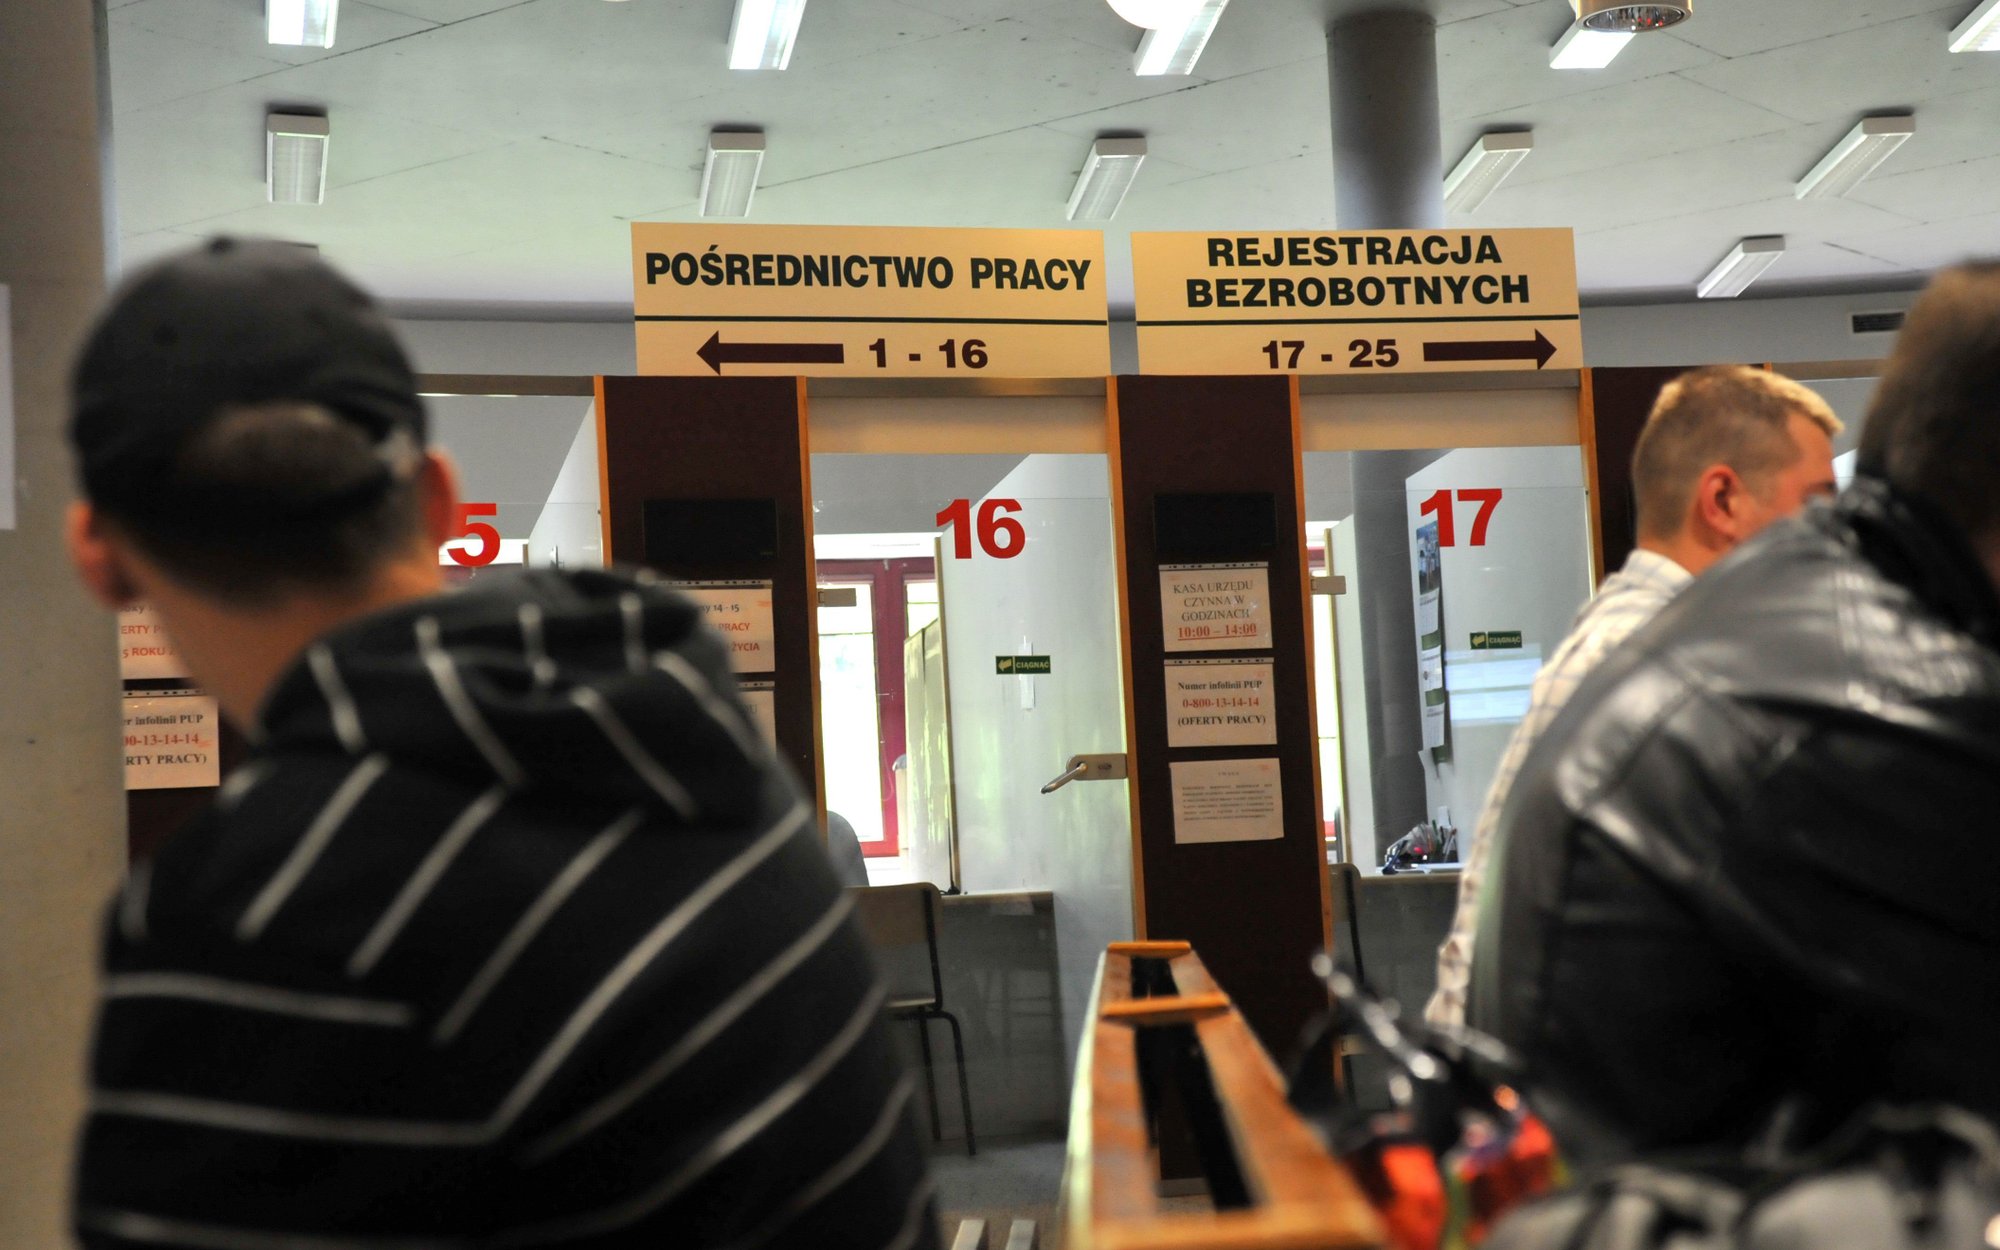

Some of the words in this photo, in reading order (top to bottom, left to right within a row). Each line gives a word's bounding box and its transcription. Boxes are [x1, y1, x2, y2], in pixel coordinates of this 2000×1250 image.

[1207, 235, 1502, 267] REJESTRACJA
[646, 244, 953, 288] POŚREDNICTWO
[971, 257, 1091, 291] PRACY
[1186, 275, 1530, 308] BEZROBOTNYCH
[869, 338, 887, 368] 1
[909, 352, 921, 361] -
[938, 339, 989, 369] 16
[1262, 340, 1305, 369] 17
[1321, 354, 1333, 362] -
[1348, 339, 1400, 368] 25
[1420, 488, 1502, 547] 17
[447, 503, 500, 568] 5
[936, 498, 1025, 559] 16
[1173, 583, 1204, 594] KASA
[1207, 580, 1253, 593] URZĘDU
[1184, 596, 1231, 607] CZYNNA
[1234, 595, 1245, 604] W
[1181, 608, 1250, 622] GODZINACH
[121, 625, 150, 634] ERTY
[1178, 625, 1210, 638] 10:00
[1225, 623, 1257, 636] 14:00
[132, 647, 165, 657] ROKU
[1178, 682, 1207, 690] Numer
[1209, 680, 1241, 690] infolinii
[1243, 680, 1263, 688] PUP
[1182, 696, 1260, 709] 0-800-13-14-14
[135, 715, 176, 725] infolinii
[180, 714, 203, 724] PUP
[1177, 717, 1223, 727] (OFERTY
[1227, 715, 1266, 725] PRACY)
[157, 753, 207, 765] PRACY)
